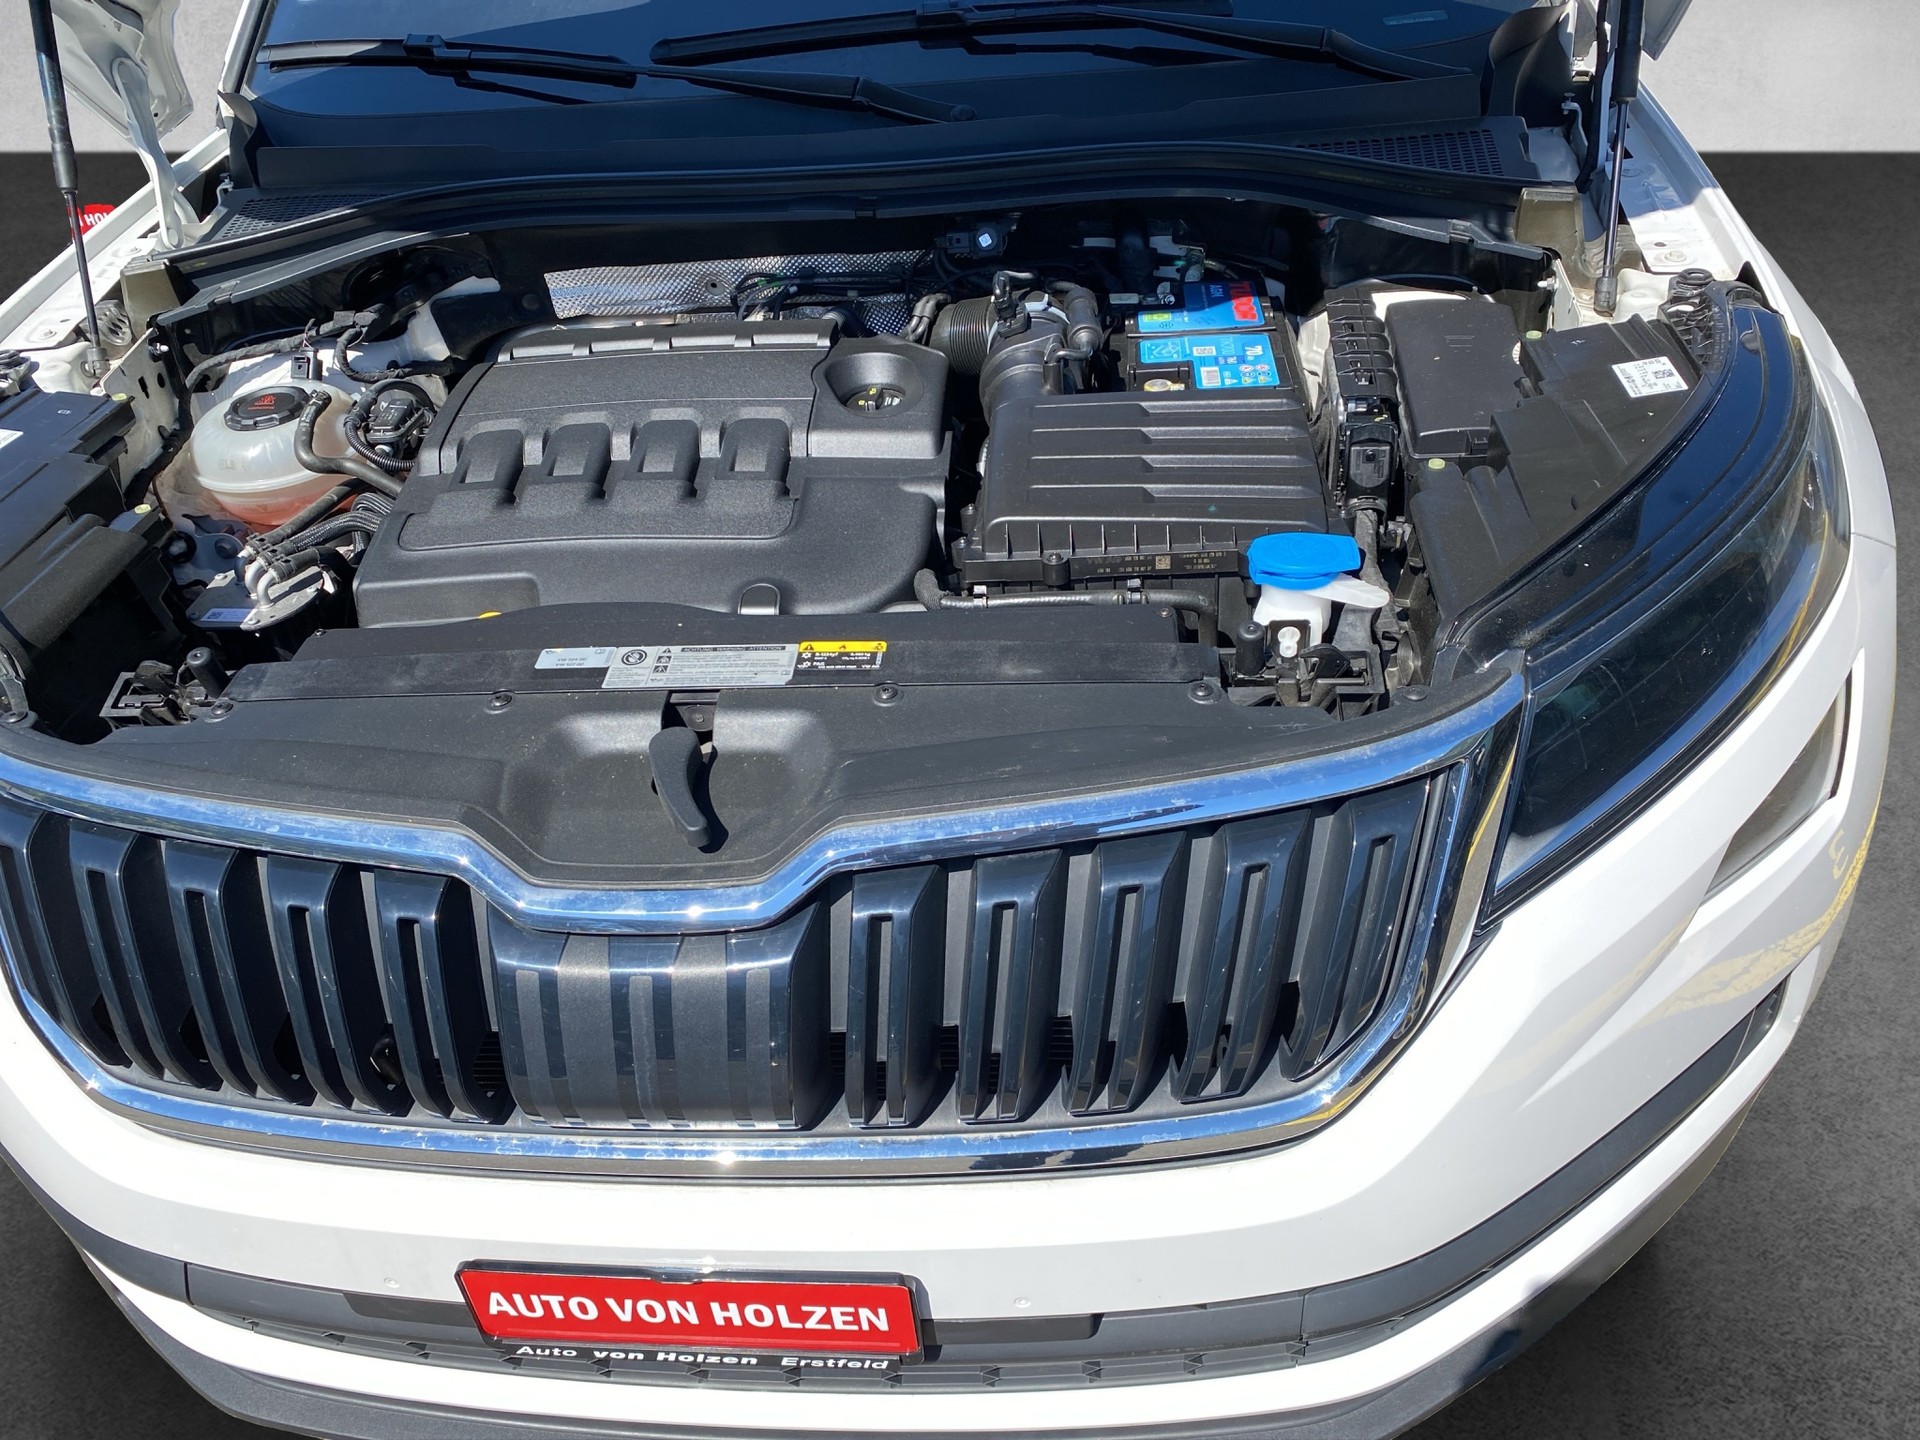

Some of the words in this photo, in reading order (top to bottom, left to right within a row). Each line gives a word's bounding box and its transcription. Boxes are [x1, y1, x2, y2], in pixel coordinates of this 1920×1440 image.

[488, 1291, 599, 1321] AUTO
[604, 1297, 700, 1325] VON
[709, 1301, 890, 1332] HOLZEN
[516, 1346, 578, 1357] Auto
[593, 1350, 645, 1360] von
[656, 1352, 759, 1366] Holzen
[780, 1357, 889, 1370] Erstfeld
